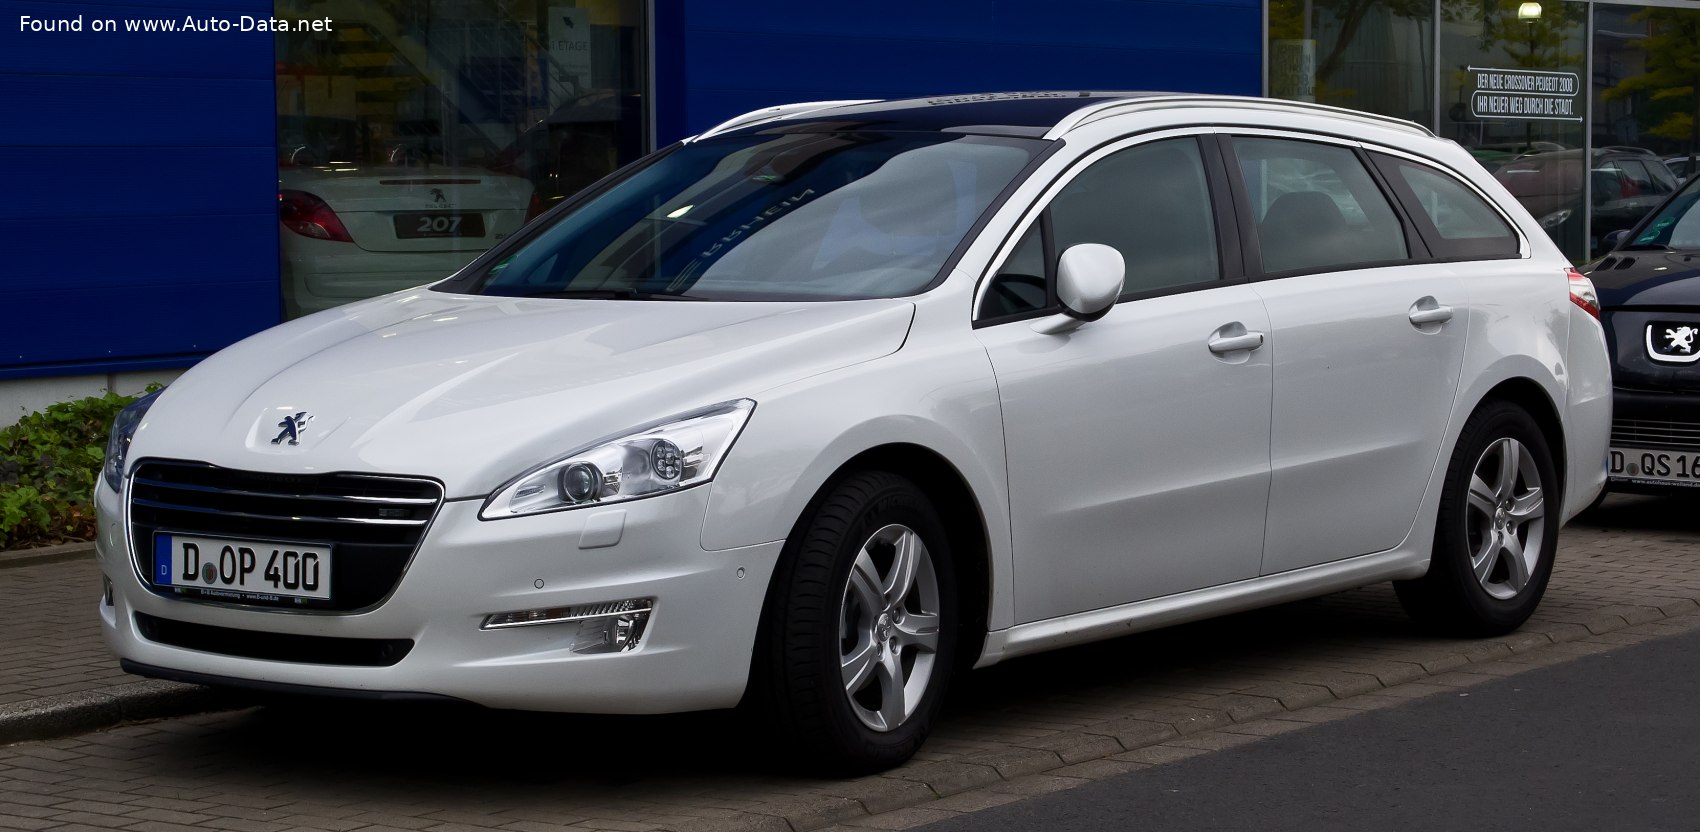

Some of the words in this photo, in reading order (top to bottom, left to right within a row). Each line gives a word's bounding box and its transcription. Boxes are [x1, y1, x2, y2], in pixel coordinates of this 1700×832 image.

[1477, 73, 1489, 89] DER
[1489, 74, 1504, 90] NEUE
[1504, 74, 1535, 91] CROSSOVER
[1535, 76, 1559, 92] PEUGEOT
[1559, 77, 1573, 93] 2008
[1477, 95, 1488, 113] IHR
[1489, 96, 1509, 113] NEUER
[1509, 97, 1523, 114] WEG
[1523, 97, 1543, 115] DURCH
[1544, 98, 1554, 115] DIE
[416, 216, 463, 233] 207
[1610, 450, 1625, 473] D
[1640, 453, 1671, 477] QS
[161, 564, 168, 576] D
[182, 542, 200, 581] D
[219, 544, 256, 586] OP
[264, 550, 321, 592] 400
